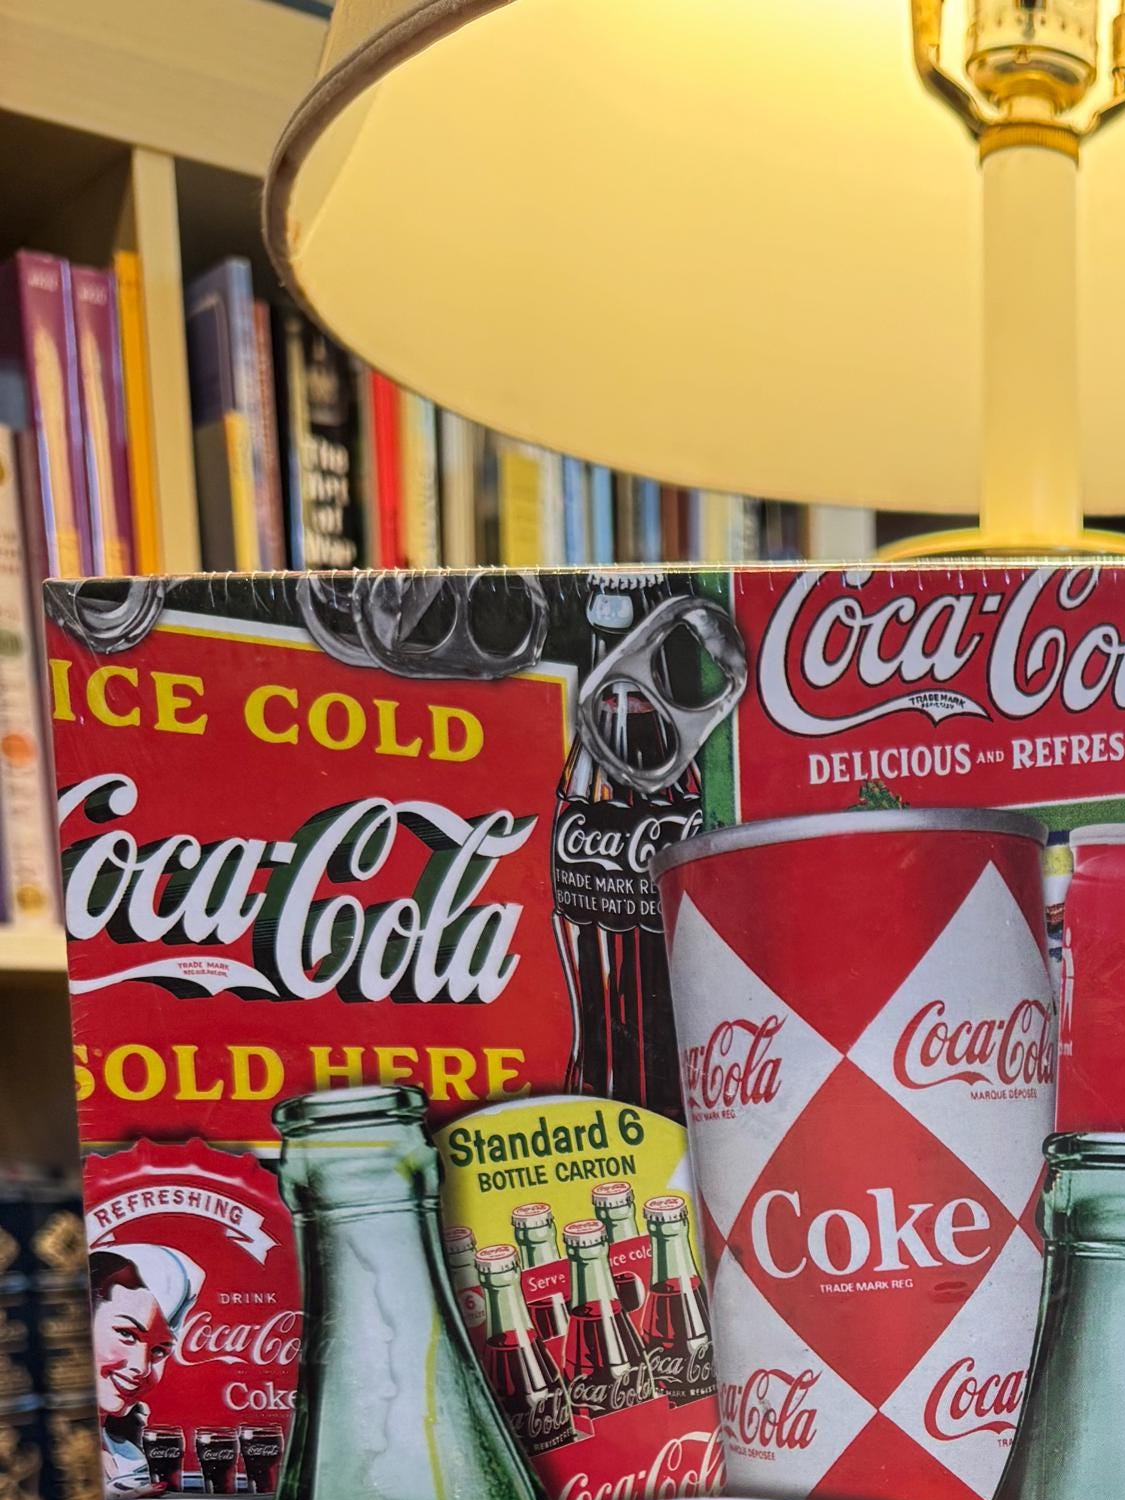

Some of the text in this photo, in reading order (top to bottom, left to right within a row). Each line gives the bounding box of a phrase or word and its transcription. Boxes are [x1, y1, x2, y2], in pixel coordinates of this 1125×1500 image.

[52, 658, 486, 763] ICE COLD
[808, 742, 972, 786] DELICIOUS
[975, 749, 1006, 765] AND
[555, 868, 593, 890] TRADE
[596, 877, 635, 895] MARK
[558, 890, 598, 912] BOTTLE
[892, 998, 1056, 1090] Coca-Cola
[74, 1043, 534, 1103] SOLD HERE
[448, 1108, 646, 1168] Standard 6
[477, 1154, 637, 1193] BOTTLE CARTON
[93, 1189, 244, 1229] REFRESHING
[750, 1186, 992, 1280] Coke
[219, 1292, 278, 1305] DRINK
[526, 1271, 567, 1292] Serve
[819, 1282, 855, 1294] TRADE
[855, 1280, 891, 1292] MARK
[171, 1310, 305, 1367] Coca-Co
[997, 1438, 1015, 1448] TRA
